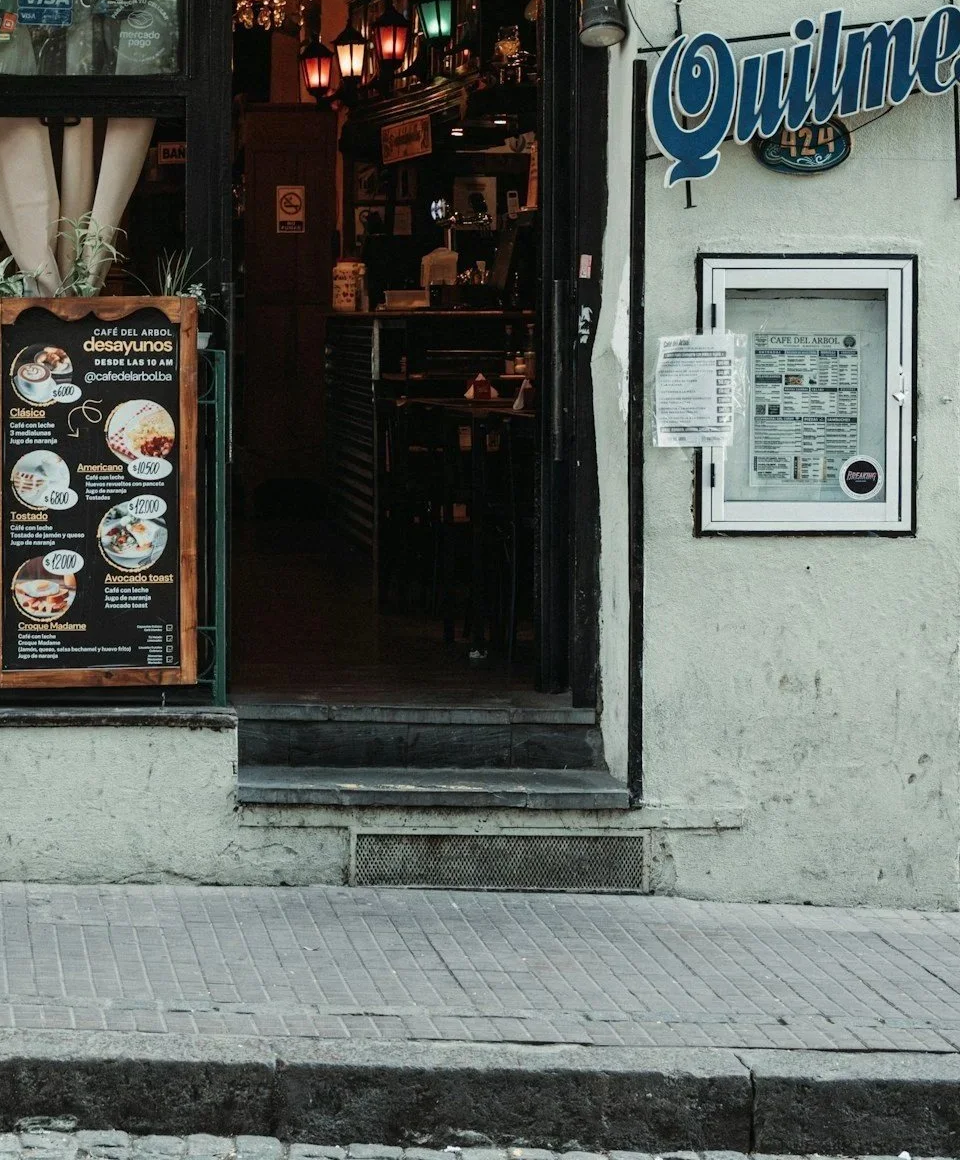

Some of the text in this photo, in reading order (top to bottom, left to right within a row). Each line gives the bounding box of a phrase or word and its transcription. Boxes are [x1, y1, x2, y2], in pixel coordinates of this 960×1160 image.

[120, 31, 160, 39] mercado
[128, 40, 152, 48] pago
[647, 5, 960, 188] Quilme
[780, 126, 835, 158] 424
[94, 327, 172, 337] CAFÉ DEL ARBOL
[770, 336, 840, 345] CAFE DEL ARBOL
[83, 336, 173, 356] desayunos
[94, 358, 124, 366] DESDE
[127, 358, 145, 366] LAS
[147, 358, 157, 366] 10
[10, 407, 46, 417] Clásico
[10, 421, 24, 429] Café
[77, 463, 123, 471] Americano
[847, 470, 877, 481] BREAKING
[10, 512, 48, 520] Tostado
[105, 573, 173, 582] Avocado toast
[18, 622, 49, 631] Croque
